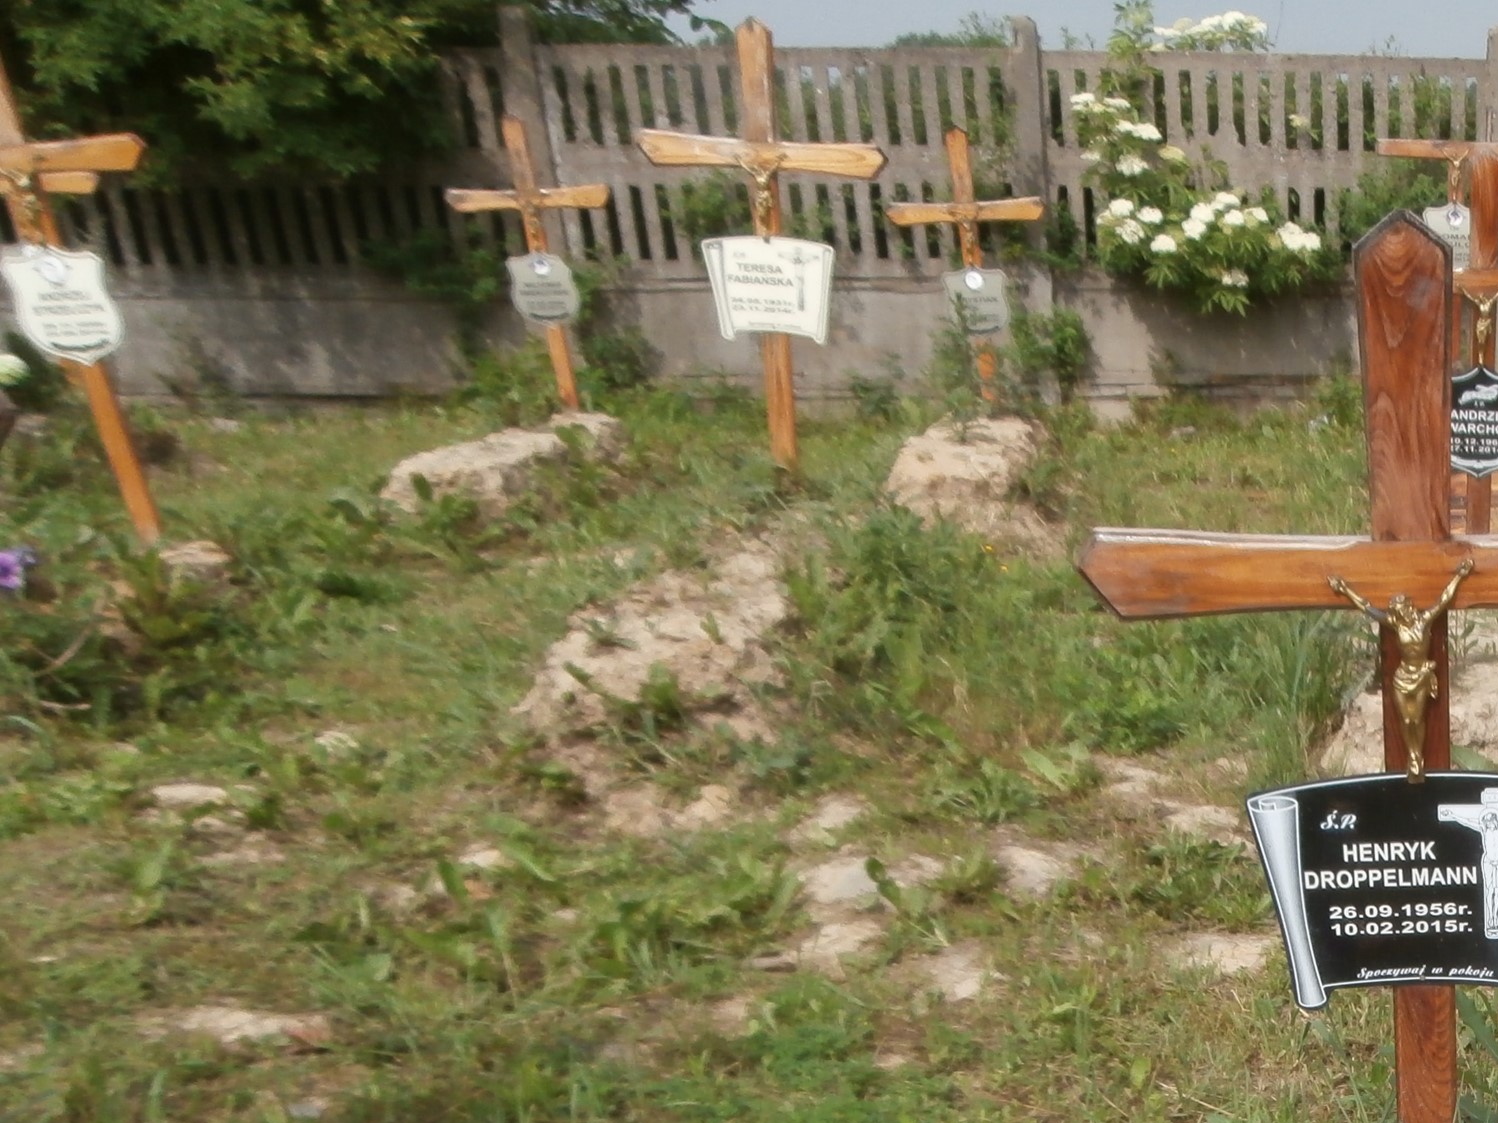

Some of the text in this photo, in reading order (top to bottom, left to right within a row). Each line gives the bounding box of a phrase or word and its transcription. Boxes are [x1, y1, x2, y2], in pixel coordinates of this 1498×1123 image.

[736, 262, 783, 274] TERESA
[1320, 811, 1358, 831] Ś.P.
[1342, 841, 1437, 863] HENRYK
[1304, 866, 1478, 890] DROPPELMANN
[1329, 903, 1473, 920] 26.09.1956r.
[1331, 920, 1473, 936] 10.02.2015r.
[1357, 964, 1495, 979] Spoczywaj w pokoju
